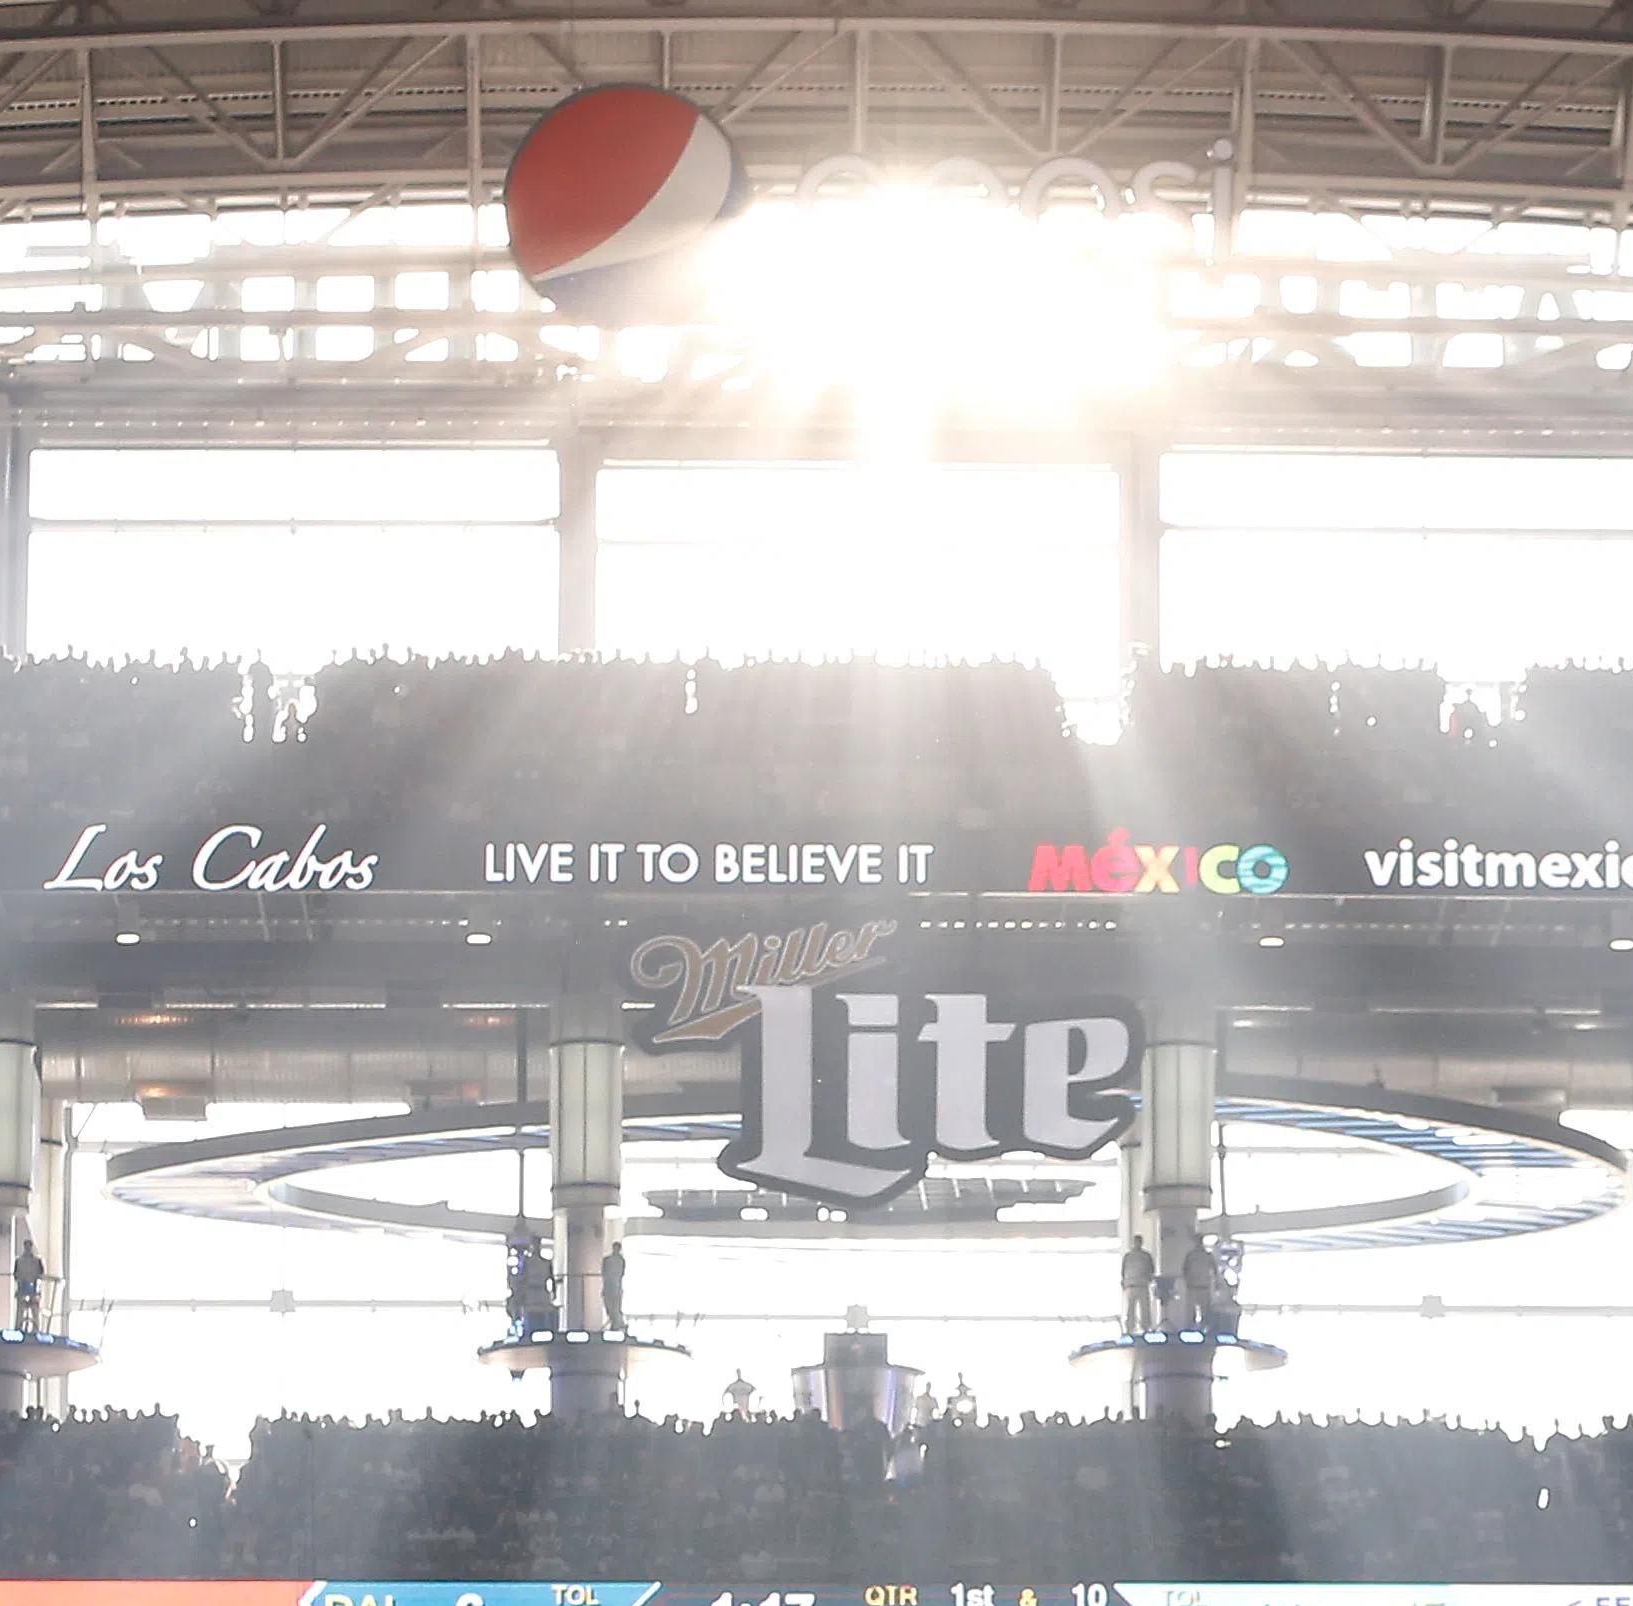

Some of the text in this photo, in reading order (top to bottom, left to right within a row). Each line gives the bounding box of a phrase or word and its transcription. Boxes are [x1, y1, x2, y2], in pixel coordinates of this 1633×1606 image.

[44, 823, 378, 893] Los Cabos
[484, 842, 934, 884] LIVE IT TO BELIEVE IT
[630, 920, 898, 1032] Miller
[735, 985, 1131, 1199] Lite
[551, 1584, 601, 1606] TOL
